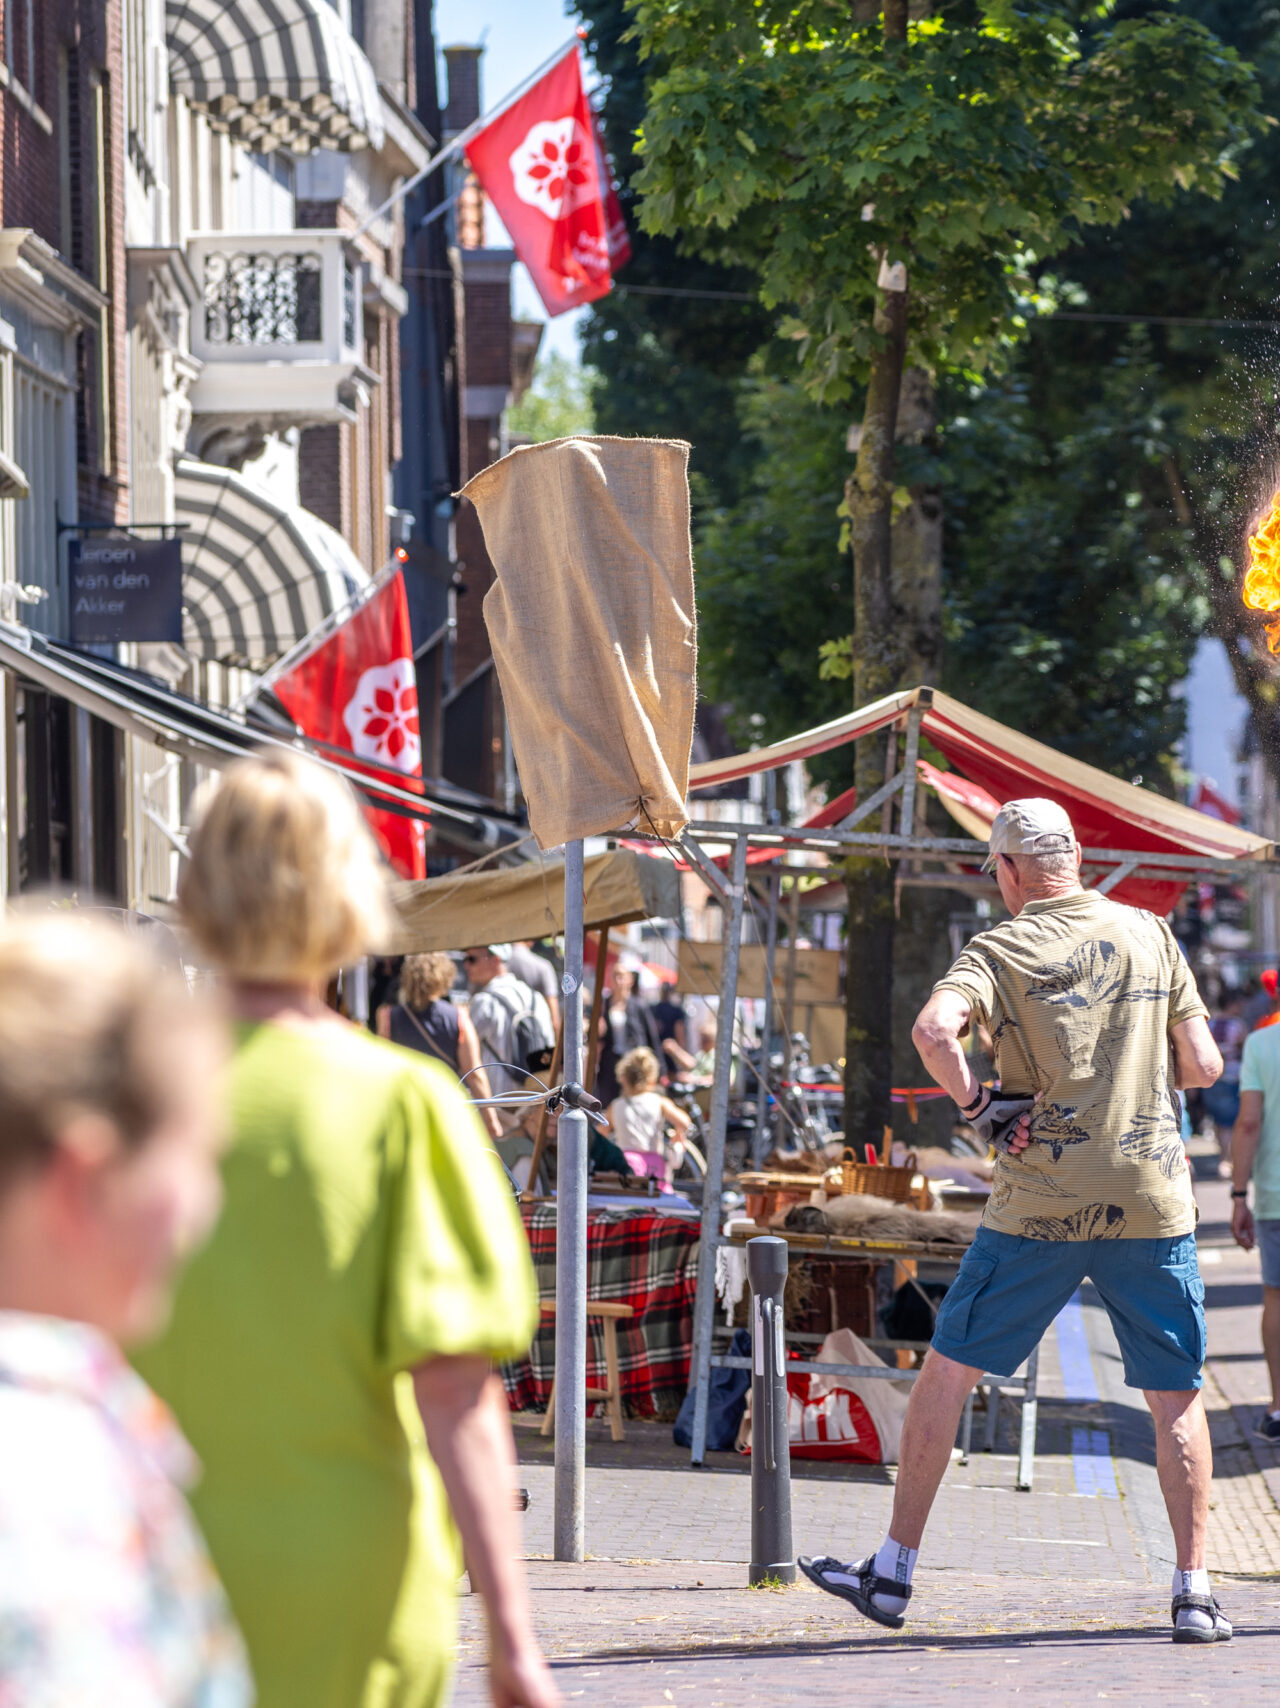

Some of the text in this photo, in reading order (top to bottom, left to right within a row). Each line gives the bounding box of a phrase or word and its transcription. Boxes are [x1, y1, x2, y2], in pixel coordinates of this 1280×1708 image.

[75, 544, 136, 564] Jeroen
[75, 569, 150, 590] van den
[75, 596, 125, 615] Akker
